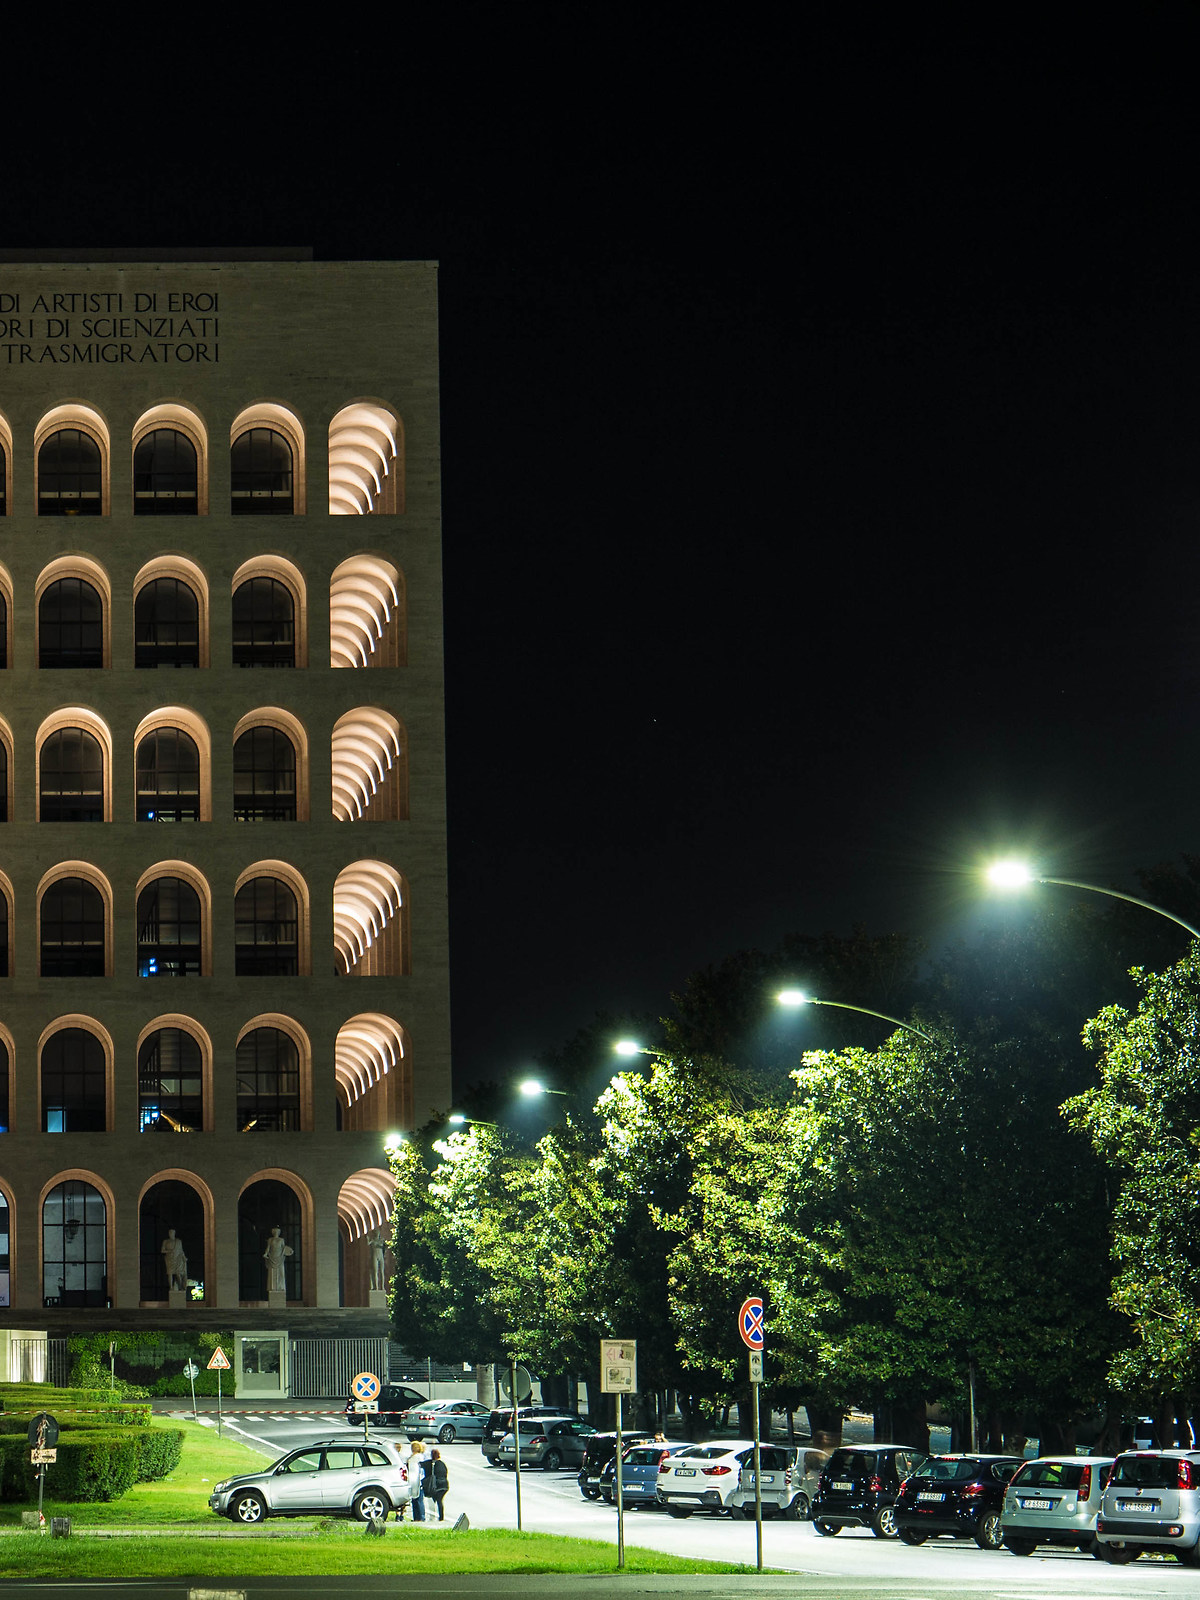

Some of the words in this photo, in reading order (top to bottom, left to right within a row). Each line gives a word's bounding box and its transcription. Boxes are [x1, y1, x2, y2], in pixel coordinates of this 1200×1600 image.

[31, 293, 123, 314] ARTISTI
[133, 292, 157, 313] DI
[168, 292, 219, 313] EROI
[45, 318, 70, 339] DI
[81, 317, 219, 339] SCIENZIATI
[1, 342, 220, 364] TRASMIGRATORI
